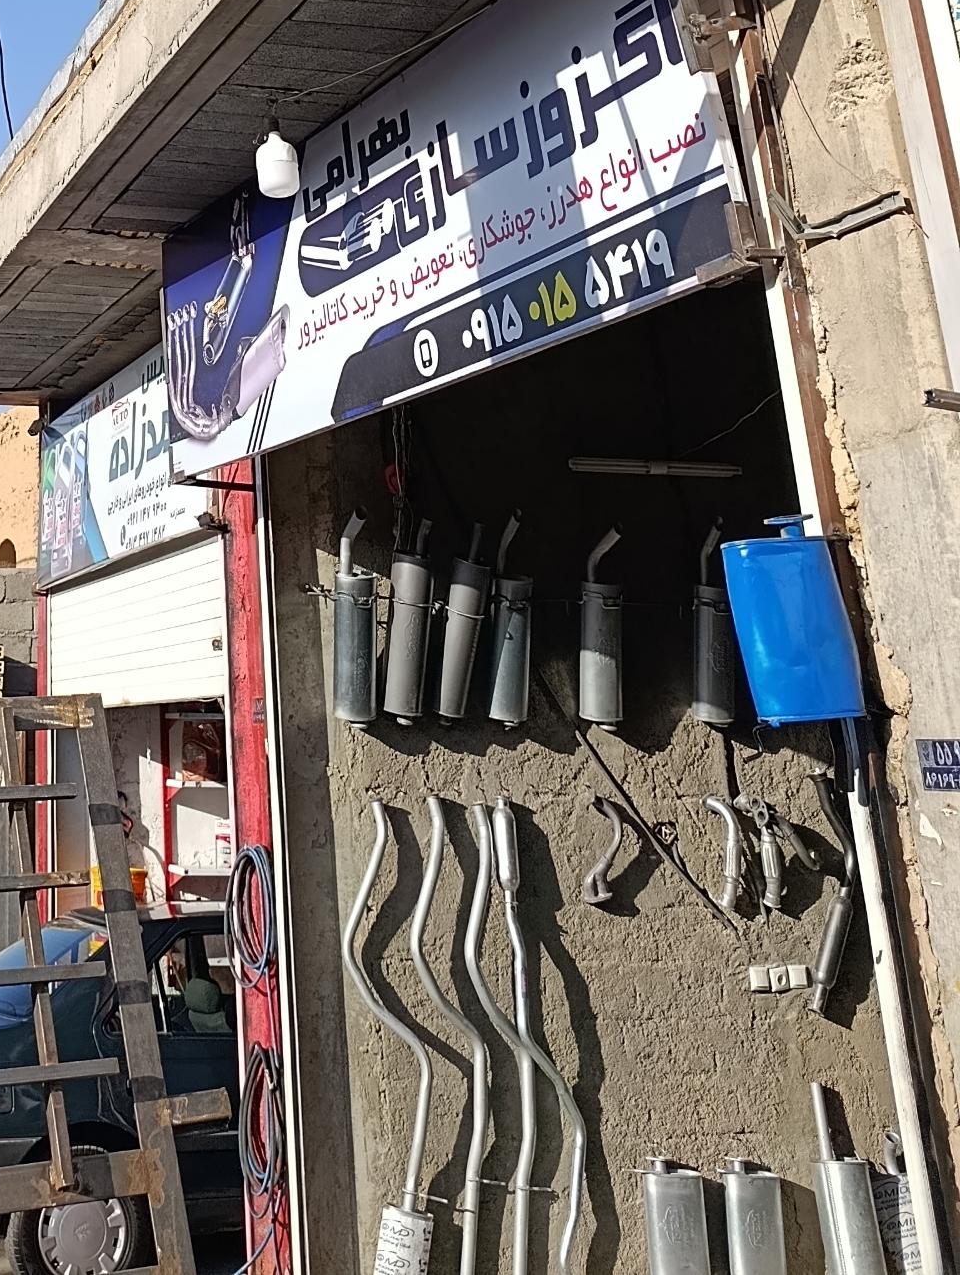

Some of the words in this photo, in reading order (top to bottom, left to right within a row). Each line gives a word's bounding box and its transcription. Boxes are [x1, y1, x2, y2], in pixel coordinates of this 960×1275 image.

[302, 108, 411, 222] بهرامی
[649, 117, 707, 165] نصب
[395, 116, 520, 254] سازی
[599, 146, 644, 213] انواع
[350, 278, 387, 320] خرید
[389, 283, 400, 307] و
[404, 247, 455, 300] تعویض
[462, 295, 522, 352] ۰۹۱۵
[527, 270, 575, 327] ۰۱۵
[584, 228, 675, 309] ۵۴۱۹
[296, 291, 347, 350] کاتالیزور
